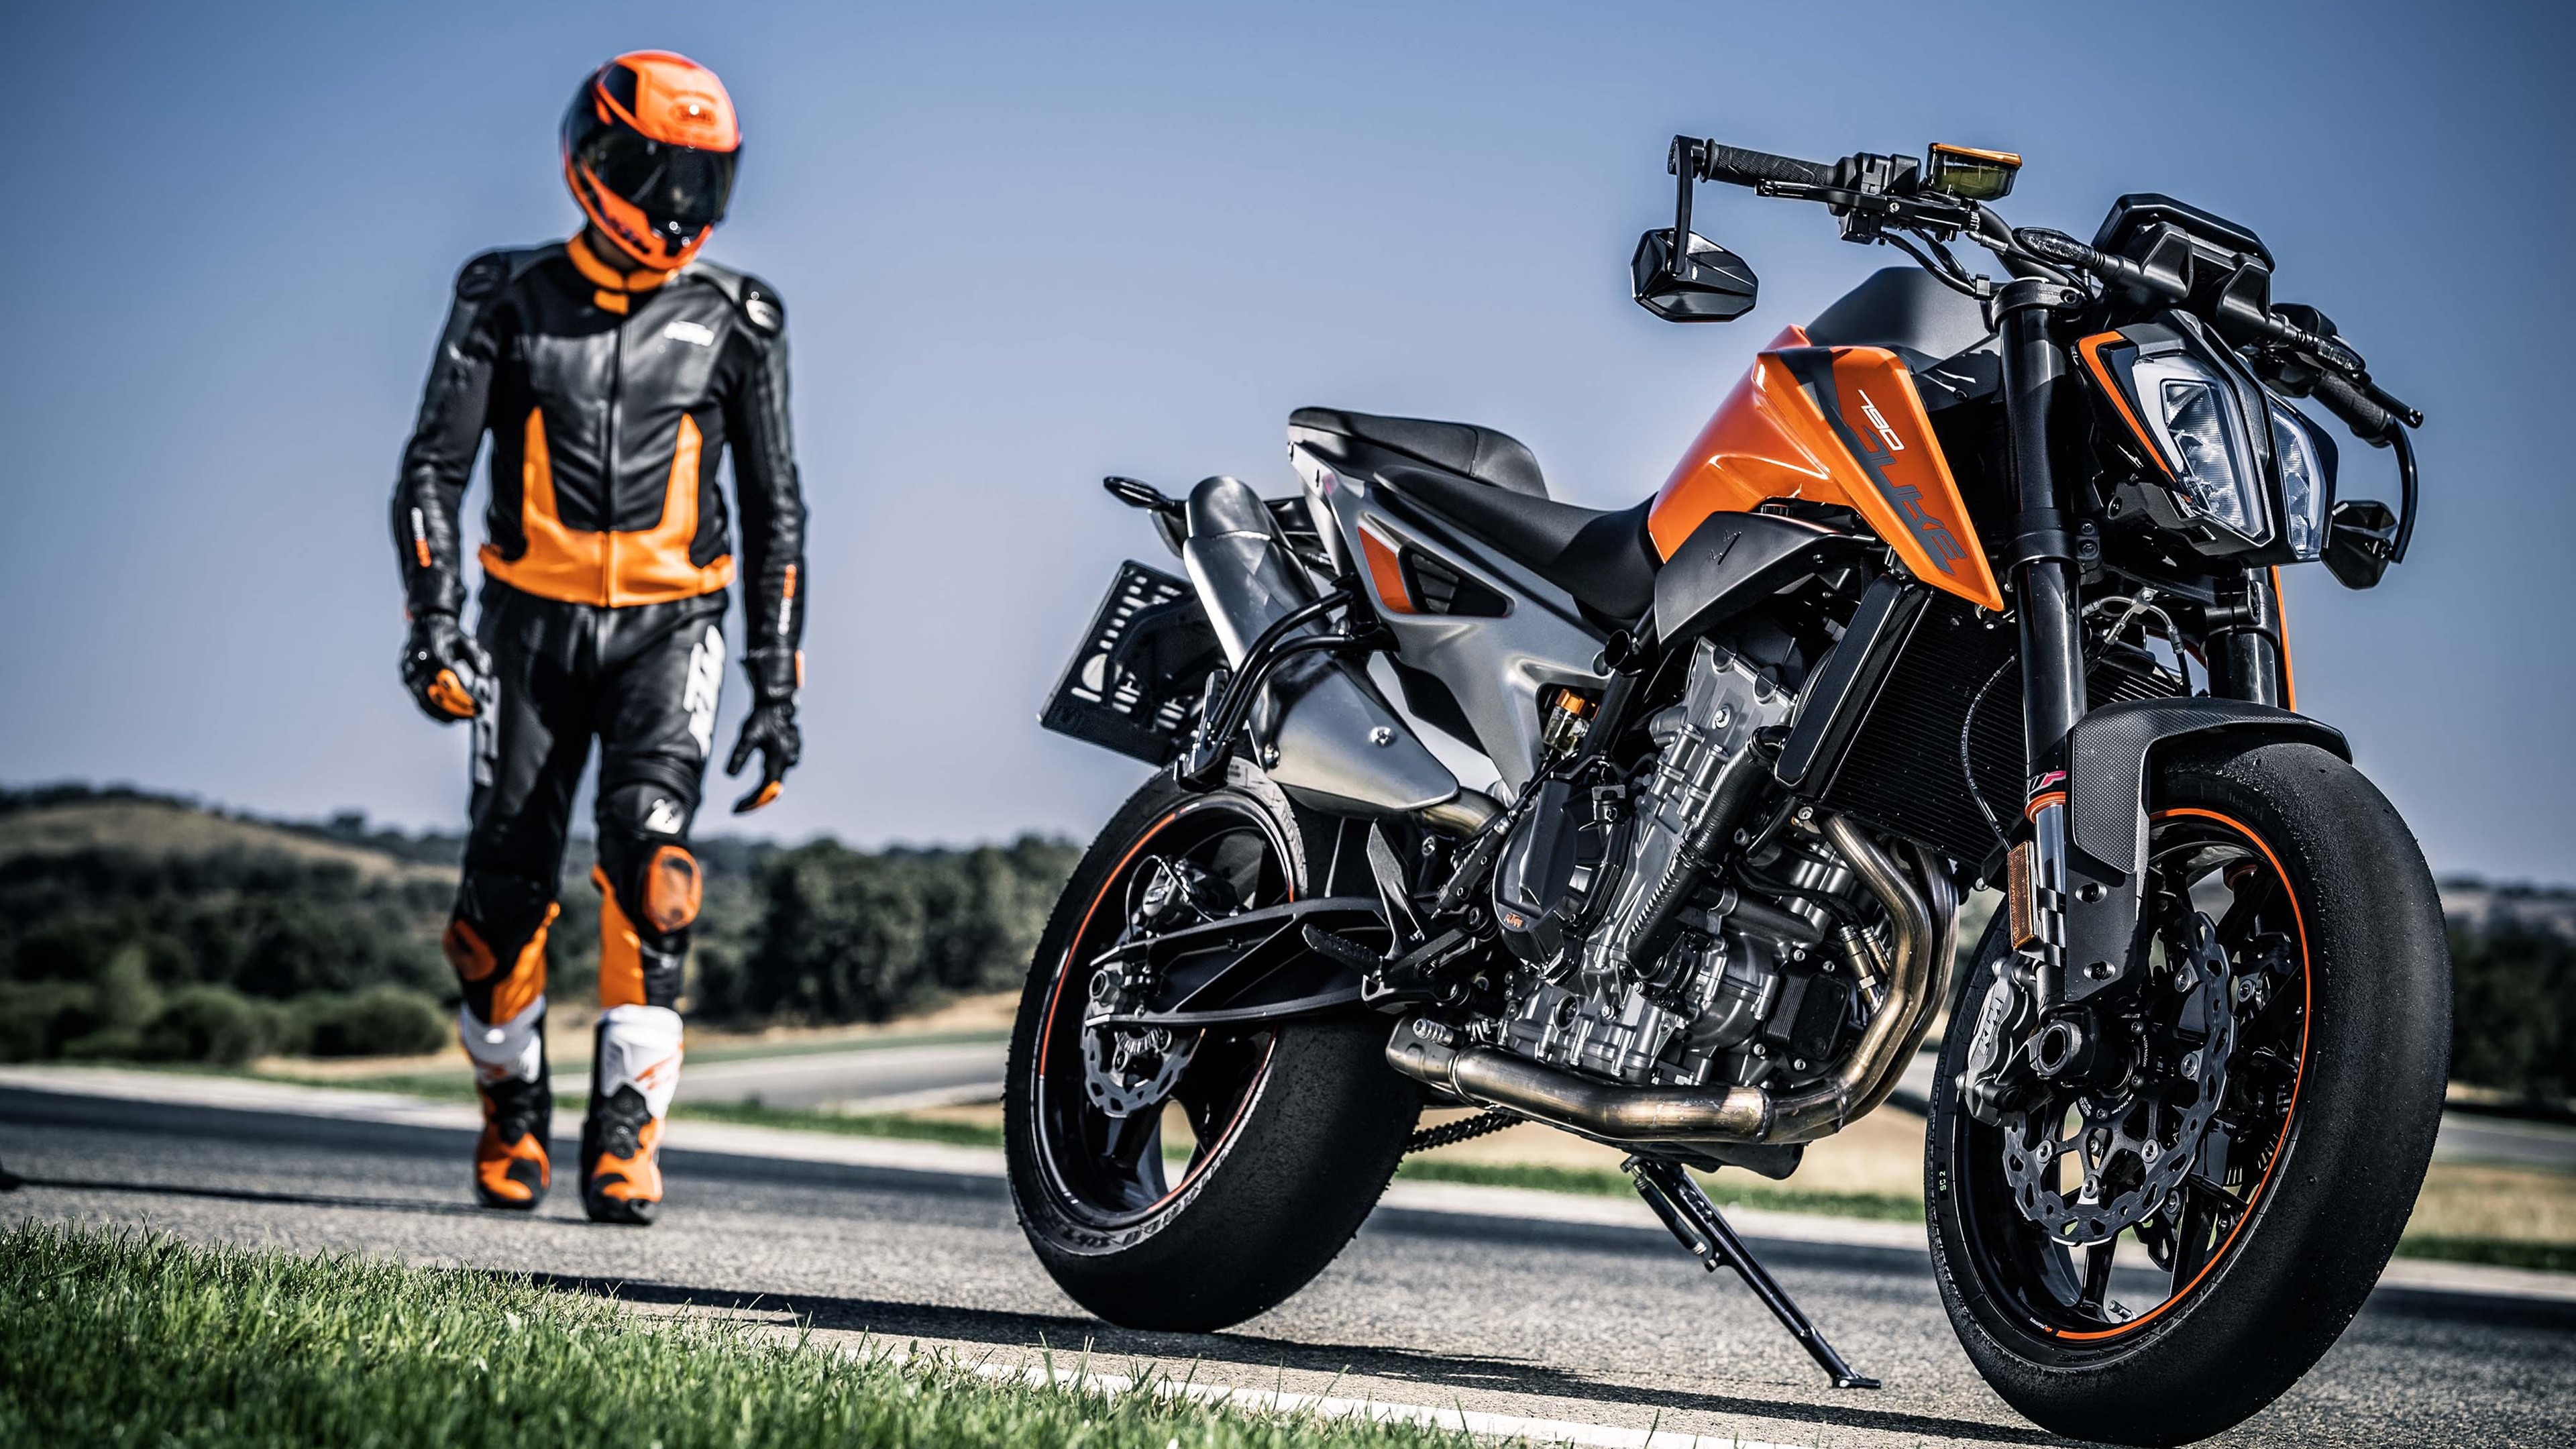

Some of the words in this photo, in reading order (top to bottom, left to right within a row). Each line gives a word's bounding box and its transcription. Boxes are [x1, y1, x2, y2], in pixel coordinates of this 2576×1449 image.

[1858, 389, 1905, 451] 790
[1853, 425, 1967, 576] DUKE
[1503, 912, 1523, 928] KTM
[1977, 997, 2004, 1056] KTM
[1939, 1179, 1947, 1191] SC
